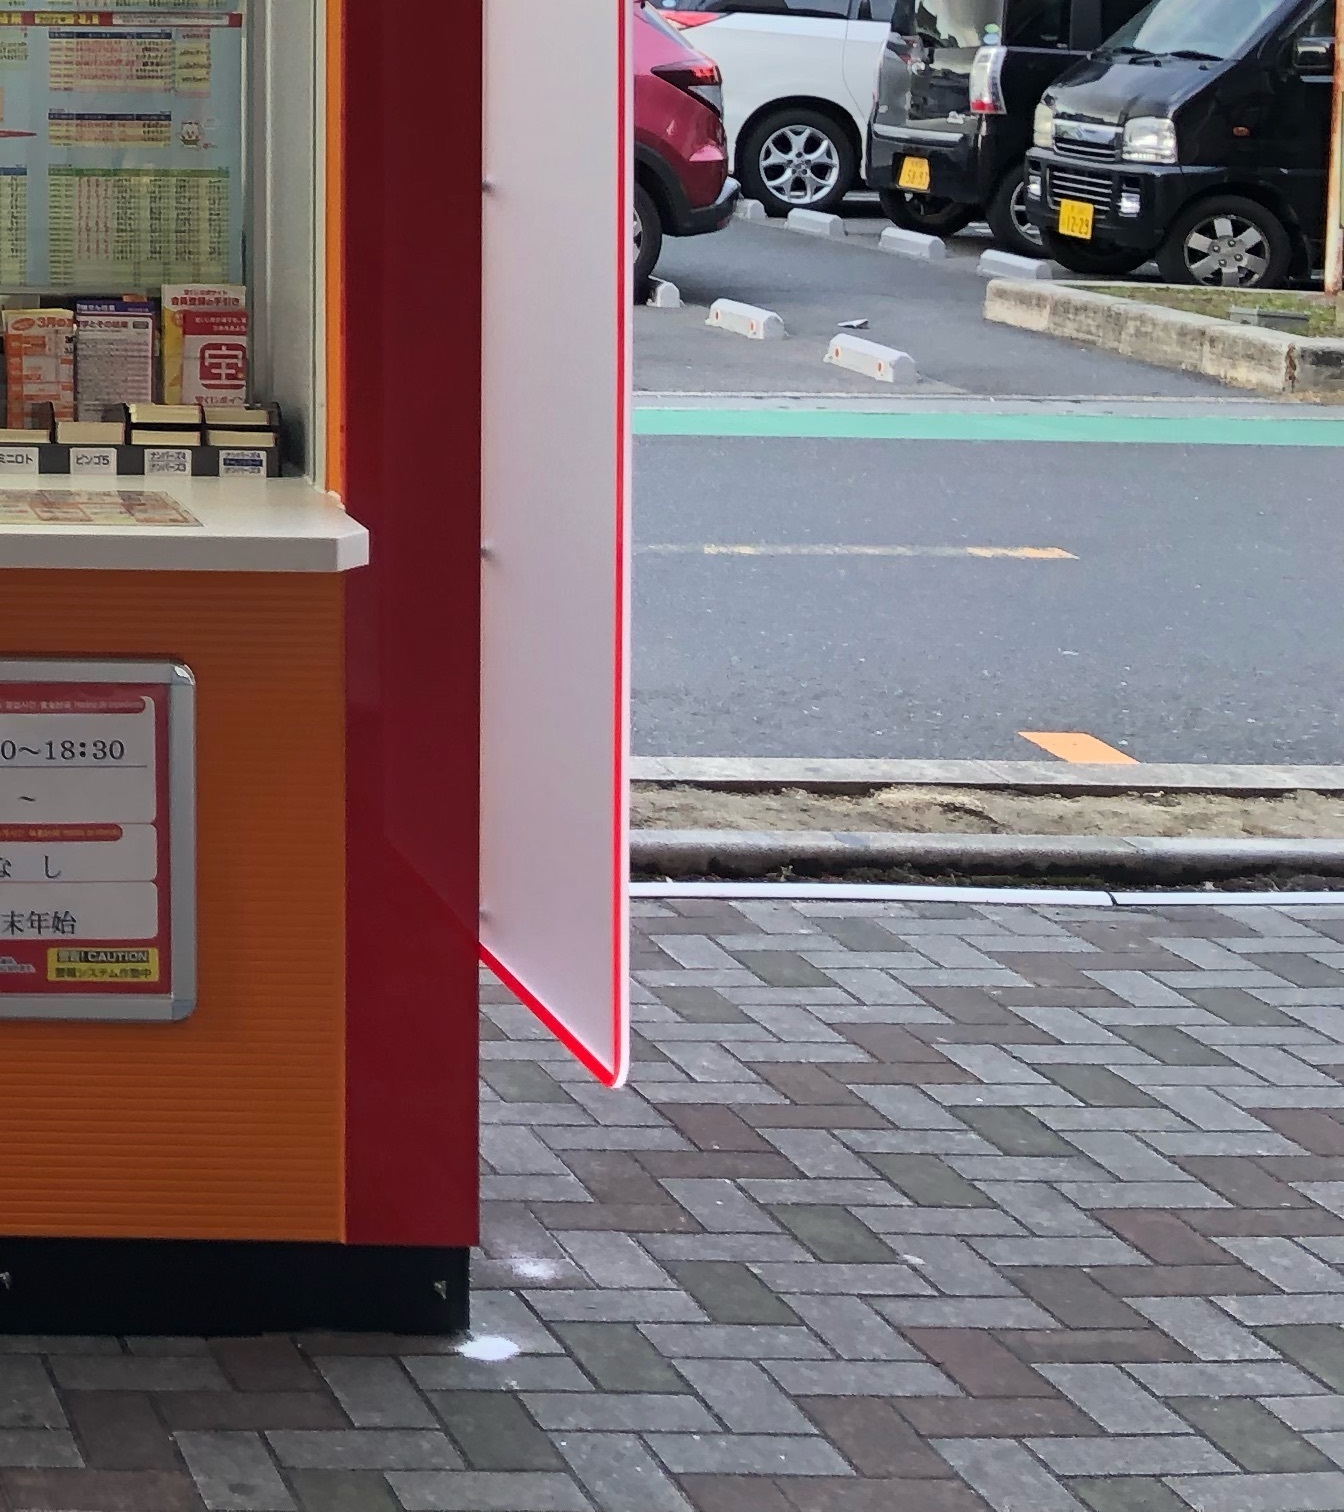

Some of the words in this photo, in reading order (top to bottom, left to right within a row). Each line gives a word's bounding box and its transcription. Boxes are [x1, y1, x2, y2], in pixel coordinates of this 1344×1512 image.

[75, 453, 110, 467] ビンゴ5
[44, 855, 62, 879] し
[88, 952, 148, 963] CAUTION
